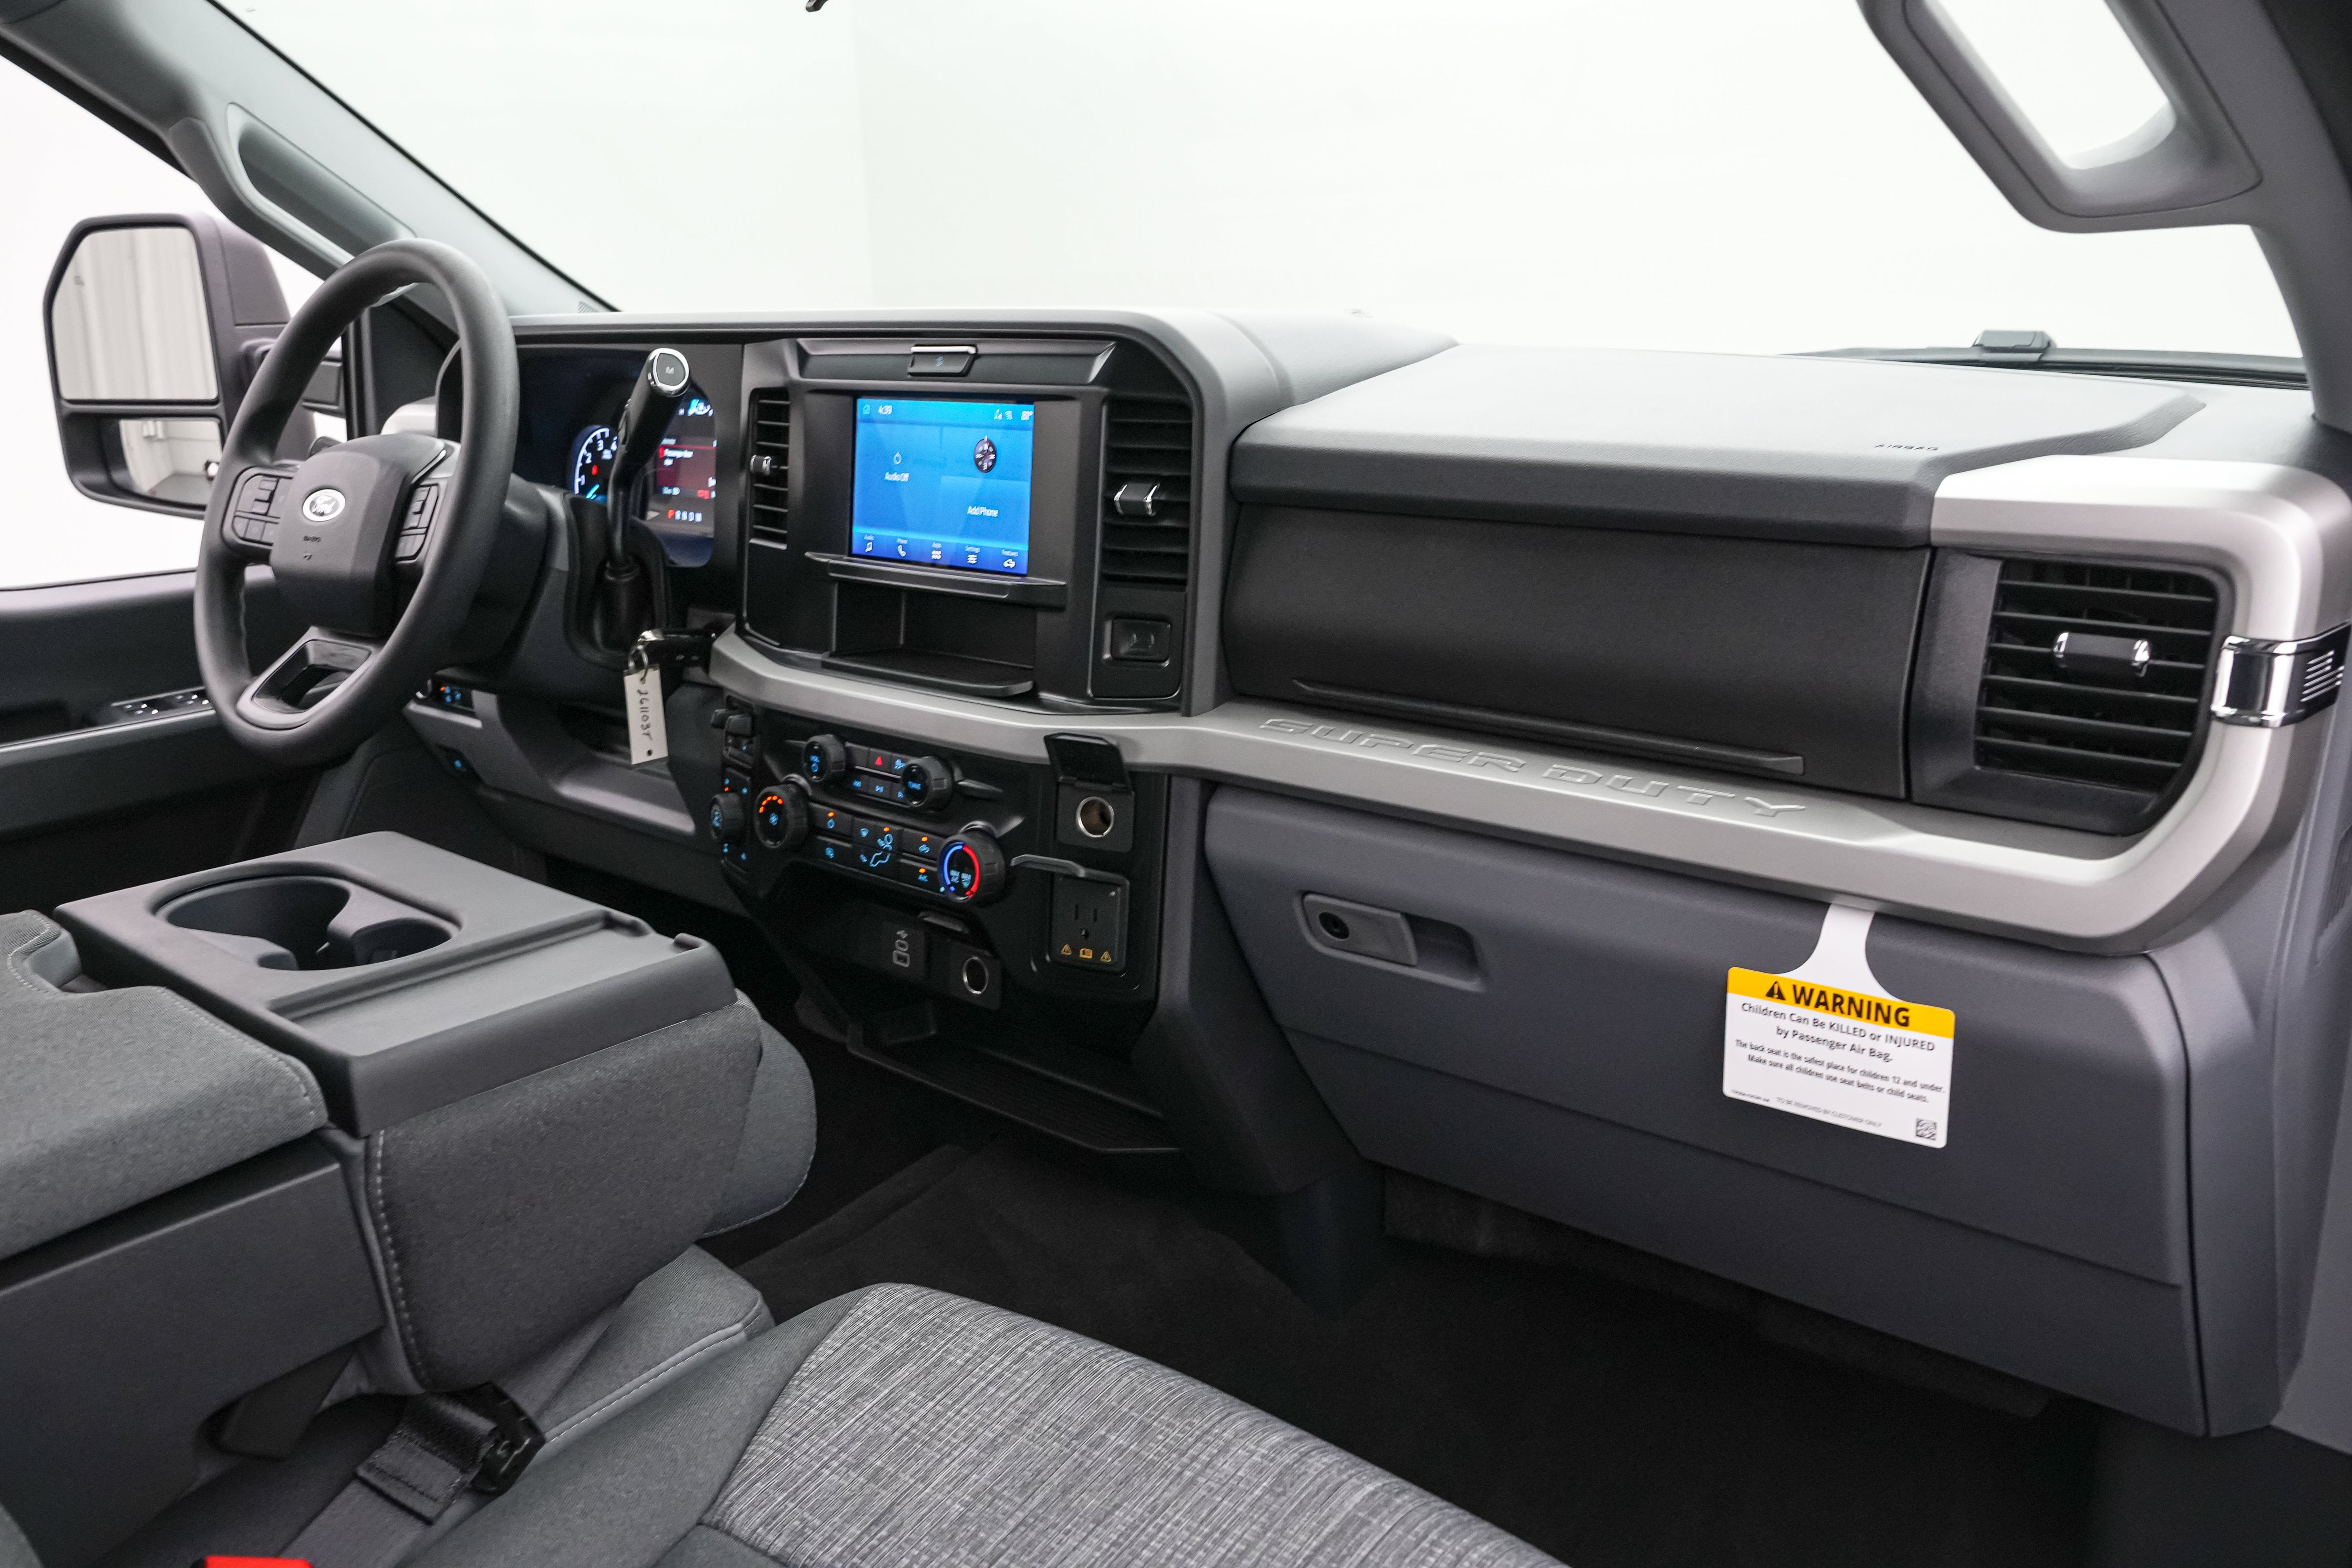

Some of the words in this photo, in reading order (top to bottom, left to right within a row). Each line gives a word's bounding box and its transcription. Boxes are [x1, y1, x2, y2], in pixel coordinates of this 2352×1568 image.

[585, 452, 592, 464] 2
[967, 505, 980, 515] Add
[980, 506, 999, 517] Phone
[1258, 718, 1526, 773] SUPER
[1541, 764, 1806, 817] DUTY
[1741, 1002, 1786, 1020] Children
[1789, 1013, 1809, 1025] Can
[1813, 1018, 1826, 1029] Be
[1829, 1021, 1866, 1038] KILLED
[1869, 1033, 1882, 1041] or
[1885, 1033, 1935, 1051] INJURED
[1792, 984, 1910, 1027] WARNING
[1776, 1025, 1789, 1038] by
[1792, 1029, 1847, 1050] Passenger
[1849, 1043, 1866, 1054] Air
[1735, 1038, 1748, 1048] The
[1749, 1042, 1765, 1052] back
[1766, 1047, 1782, 1056] seat
[1783, 1050, 1789, 1058] is
[1790, 1052, 1803, 1061] the
[1804, 1056, 1825, 1066] safest
[1826, 1061, 1845, 1071] place
[1847, 1065, 1858, 1074] for
[1859, 1068, 1890, 1082] children
[1891, 1076, 1901, 1084] 12
[1902, 1079, 1918, 1087] and
[1747, 1054, 1767, 1065] Make
[1768, 1060, 1784, 1069] sure
[1785, 1063, 1794, 1071] all
[1795, 1065, 1824, 1079] children
[1825, 1074, 1838, 1082] use
[1839, 1077, 1855, 1086] seat
[1856, 1080, 1875, 1091] belts
[1886, 1087, 1905, 1098] child
